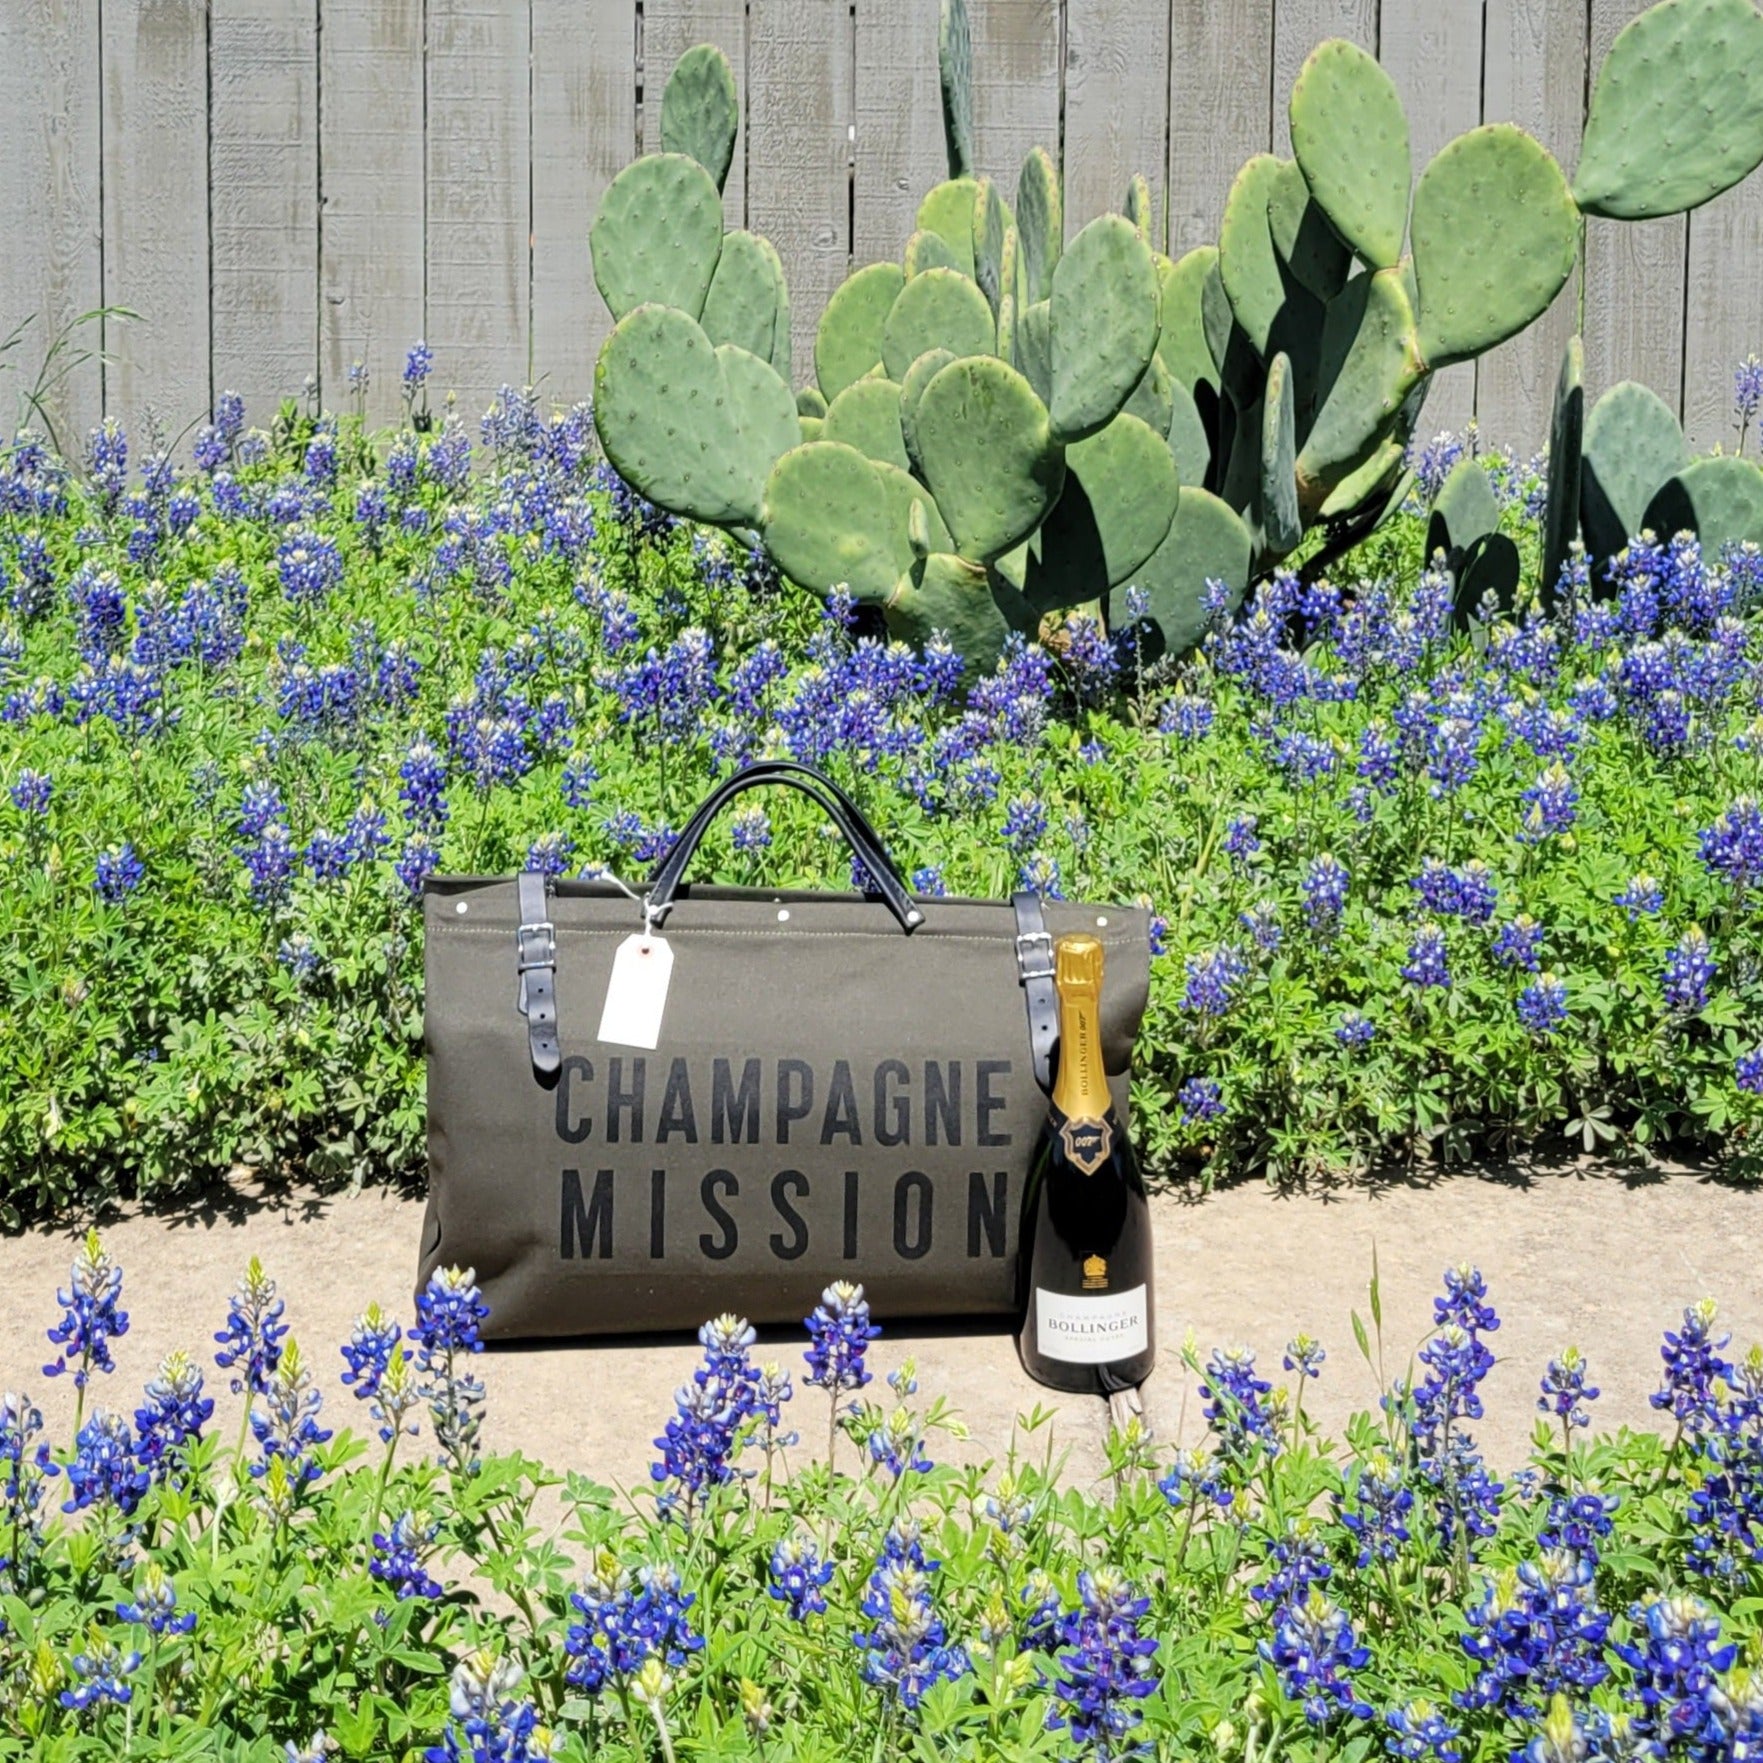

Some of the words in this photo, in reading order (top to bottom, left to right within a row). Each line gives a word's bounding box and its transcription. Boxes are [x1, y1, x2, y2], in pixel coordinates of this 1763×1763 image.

[1078, 1011, 1086, 1031] 007
[1080, 1032, 1088, 1096] BOLLINGER
[554, 1056, 1012, 1146] CHAMPAGNE
[1075, 1135, 1099, 1147] 007
[560, 1169, 1007, 1260] MISSION
[1048, 1315, 1139, 1334] BOLLINGER
